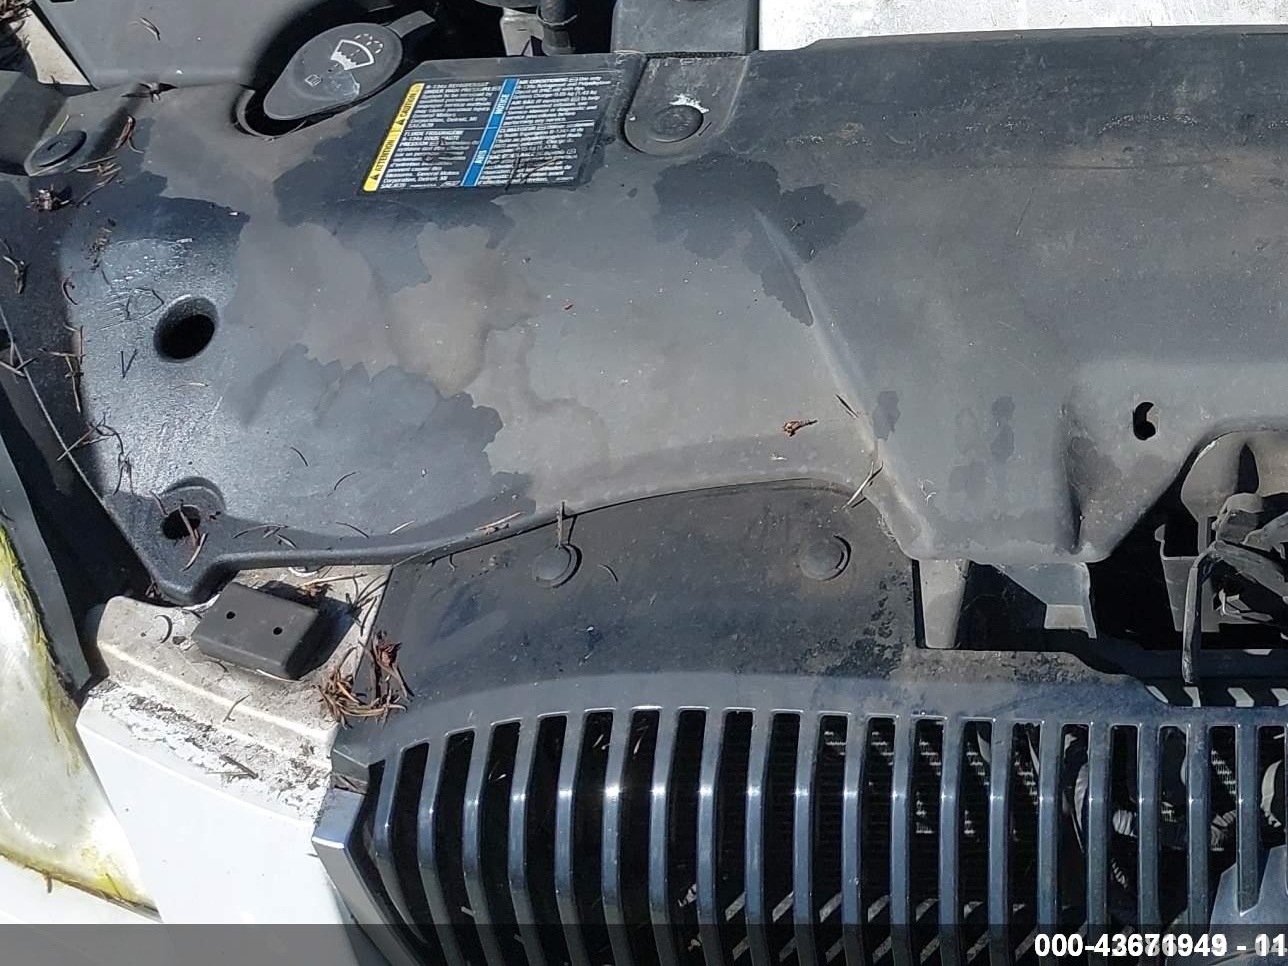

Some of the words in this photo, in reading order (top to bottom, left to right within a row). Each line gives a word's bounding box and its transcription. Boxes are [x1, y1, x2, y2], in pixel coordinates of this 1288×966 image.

[399, 92, 418, 117] CAUTION
[494, 94, 510, 115] NOTICE
[374, 139, 396, 172] ATTENTION
